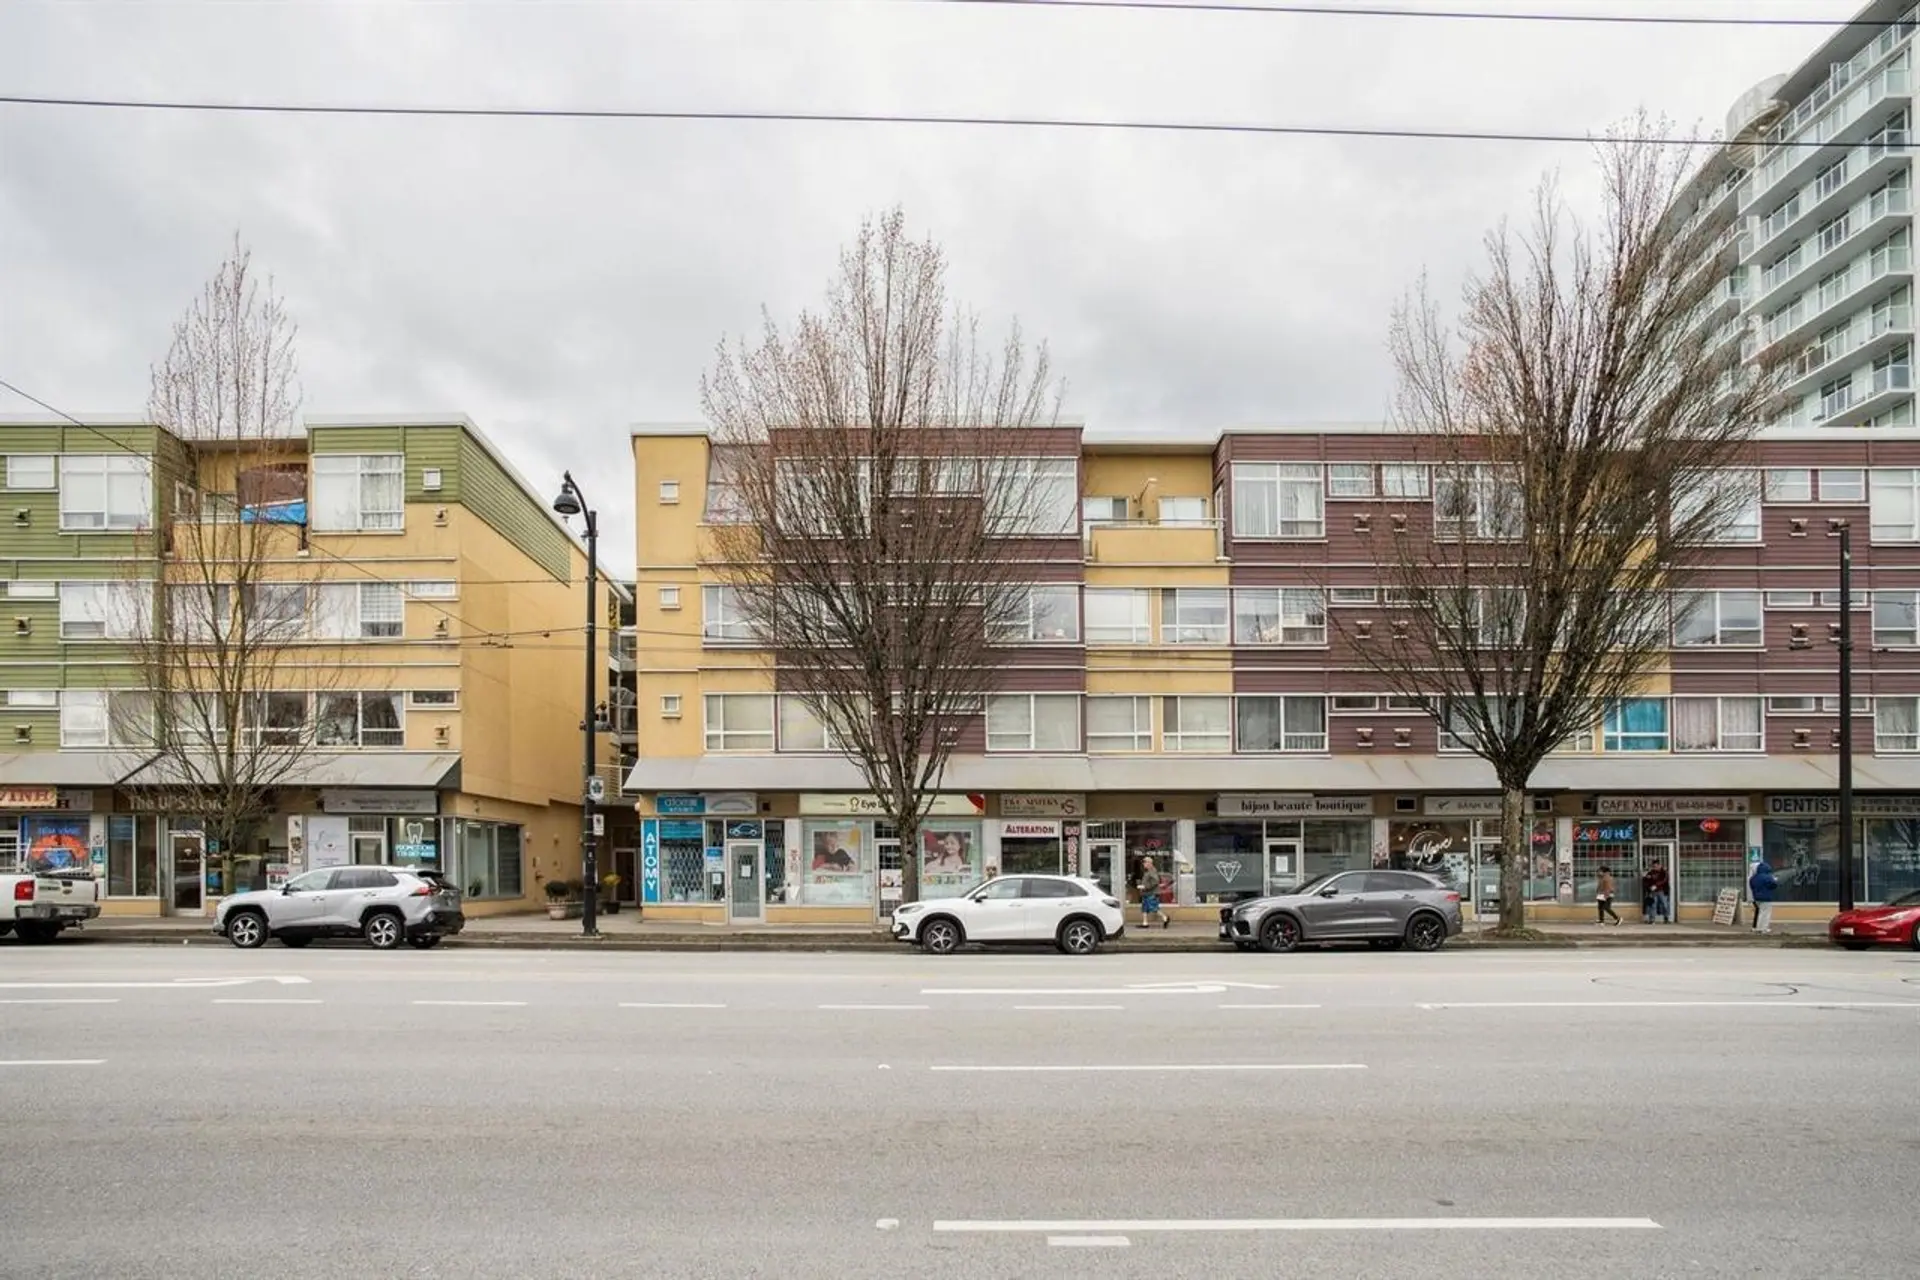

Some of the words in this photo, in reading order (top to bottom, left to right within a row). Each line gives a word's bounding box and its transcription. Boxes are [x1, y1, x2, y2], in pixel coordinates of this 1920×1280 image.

[128, 795, 154, 810] The
[158, 796, 187, 810] UPS
[861, 800, 876, 809] Eye
[1241, 800, 1270, 813] bijou
[1315, 800, 1367, 813] boutique
[1772, 798, 1840, 812] DENTIST
[1005, 825, 1054, 834] ALTERATION
[645, 832, 657, 891] ATOMY
